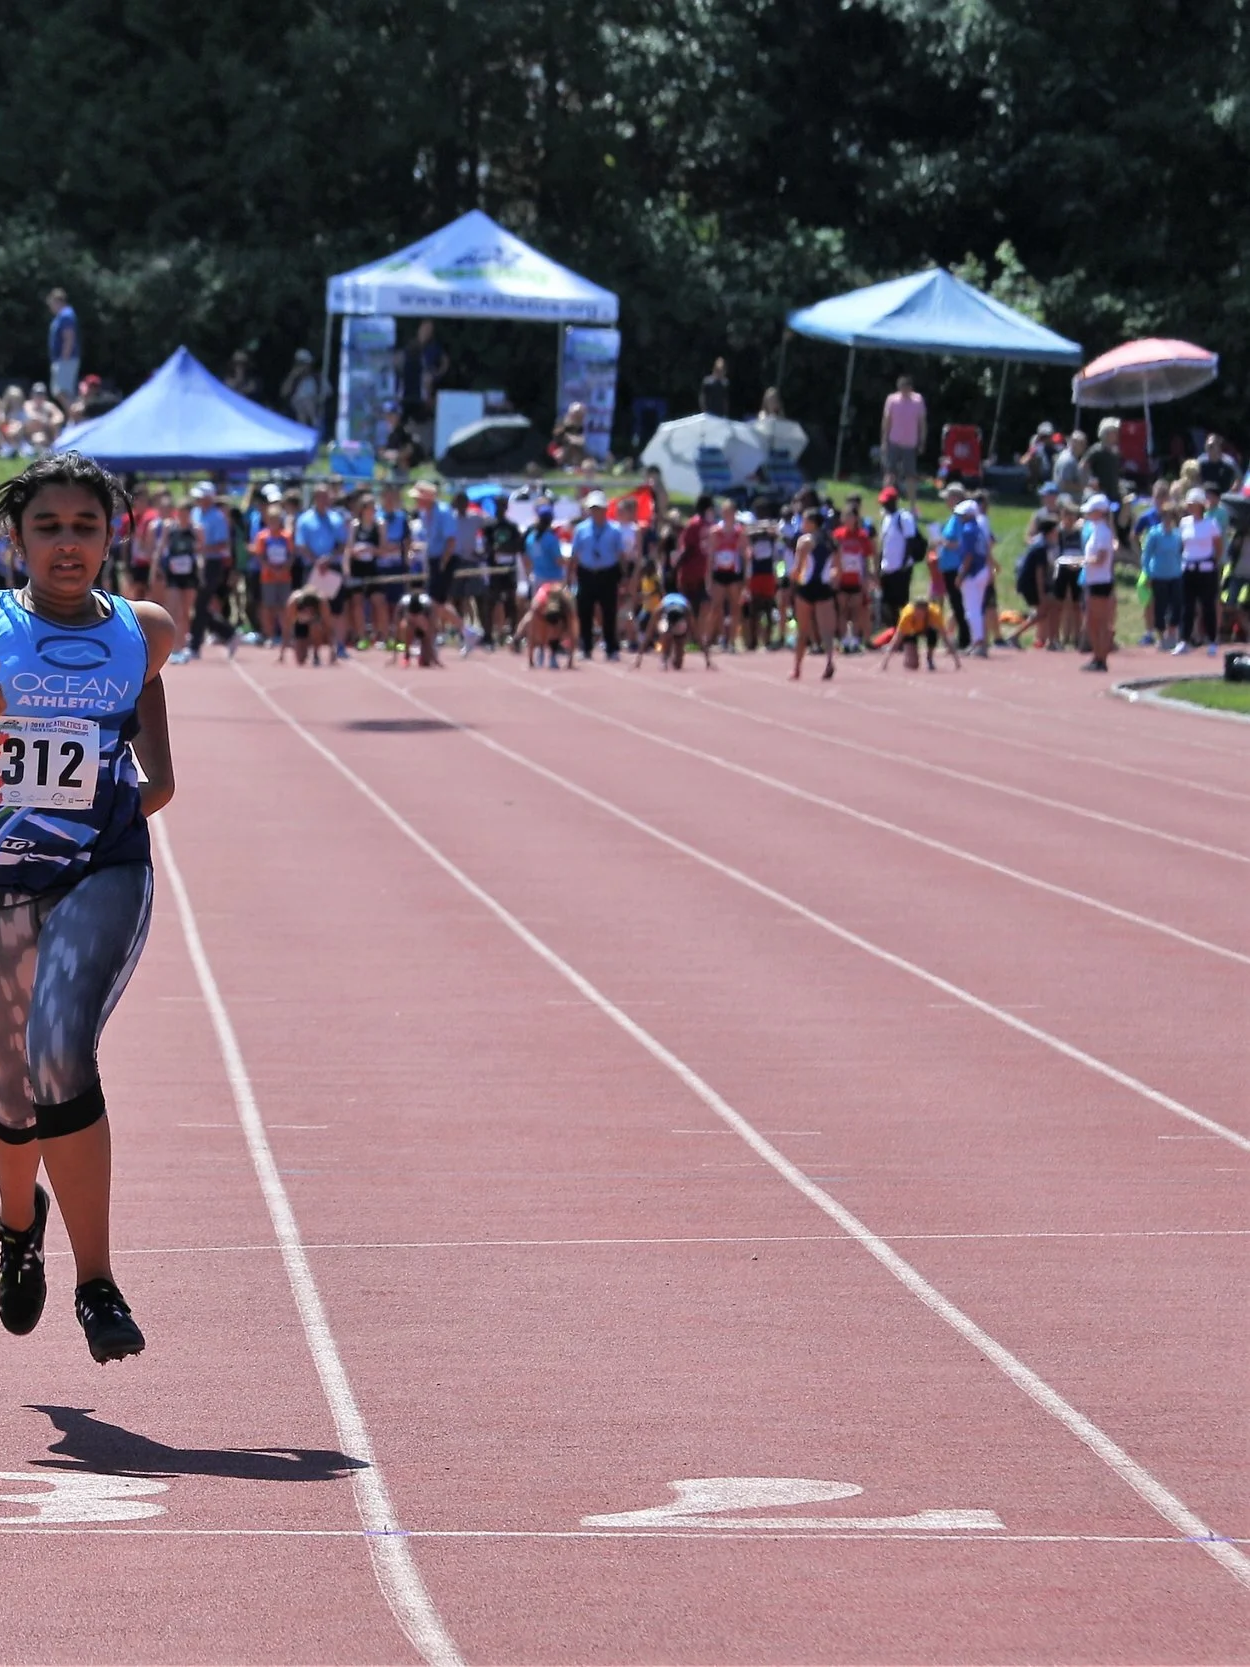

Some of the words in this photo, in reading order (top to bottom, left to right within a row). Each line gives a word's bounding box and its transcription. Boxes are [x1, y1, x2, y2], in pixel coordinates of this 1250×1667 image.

[12, 672, 129, 699] OCEAN
[17, 695, 115, 711] ATHLETICS
[53, 720, 81, 729] ATHLETICS
[2, 737, 84, 788] 312
